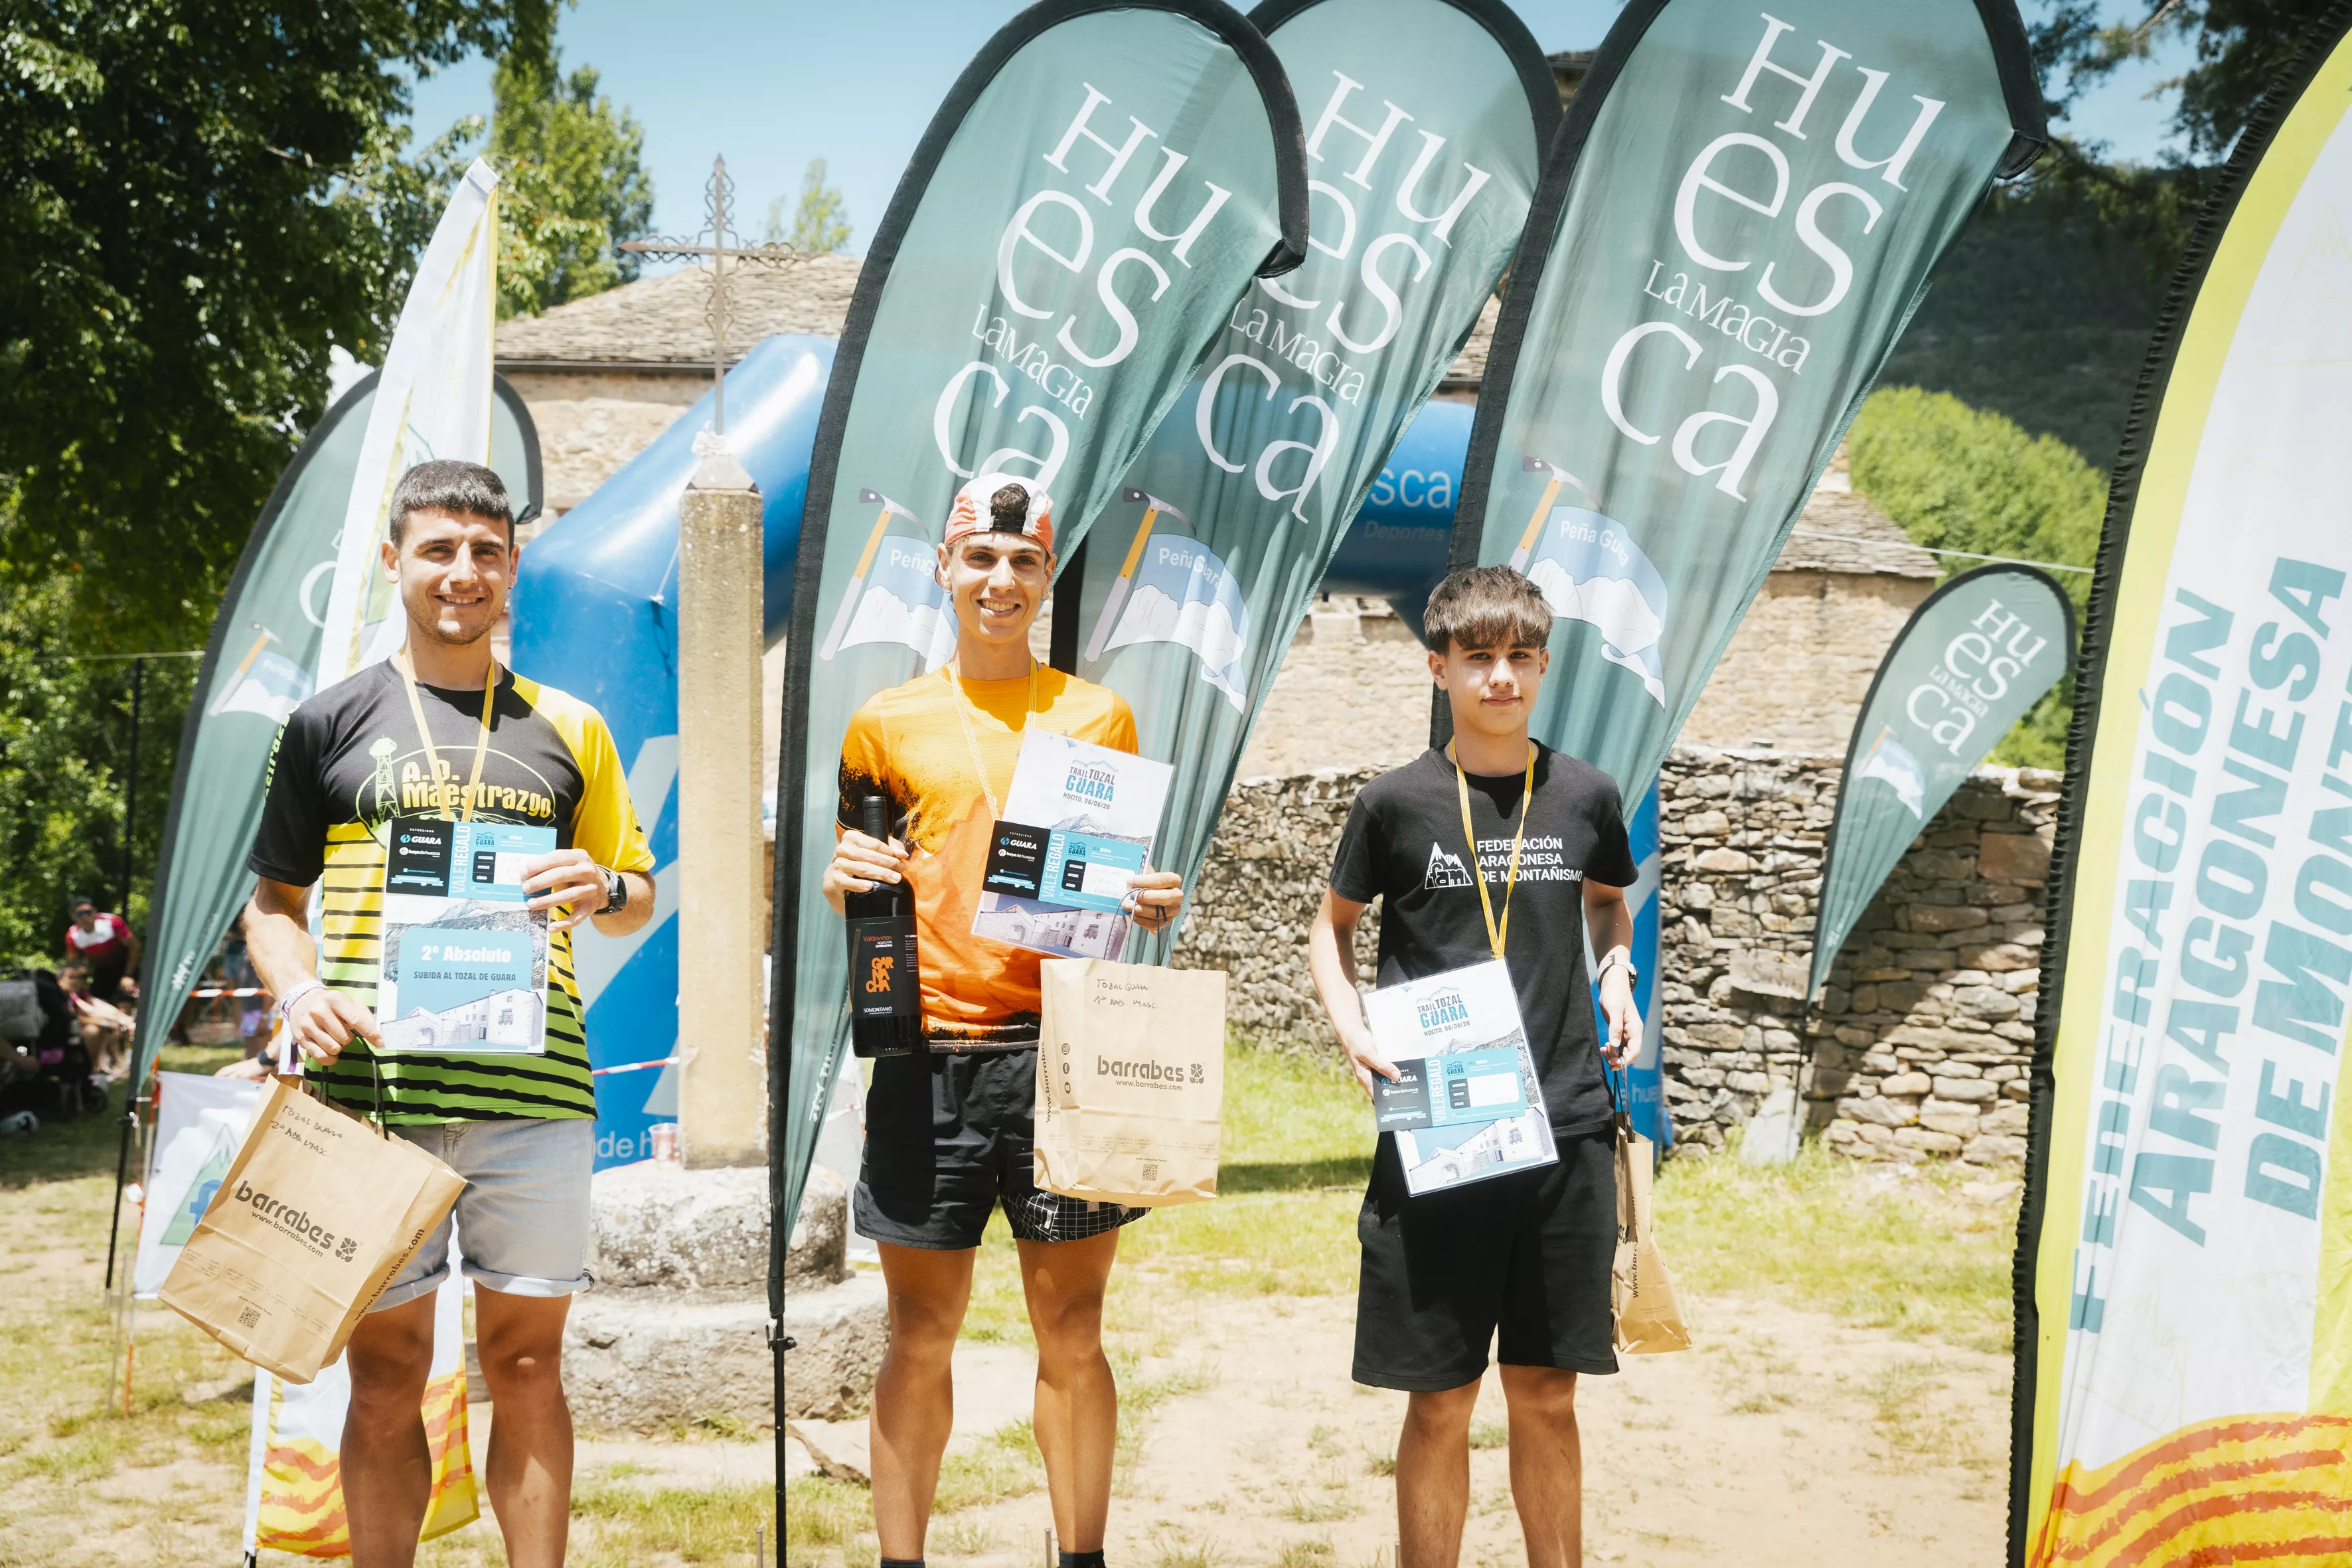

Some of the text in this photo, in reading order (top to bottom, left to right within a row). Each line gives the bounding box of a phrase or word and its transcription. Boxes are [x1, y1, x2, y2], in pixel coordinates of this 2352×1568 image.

[1721, 13, 1946, 193] Hu
[1042, 82, 1232, 268] Hu
[1306, 70, 1492, 248] Hu
[1674, 132, 1884, 317] es
[996, 189, 1171, 368] es
[1196, 353, 1340, 524] ca
[1601, 321, 1779, 503] ca
[1159, 548, 1193, 568] Peña
[1365, 520, 1445, 541] Deportes
[1560, 520, 1597, 543] Peña
[1970, 598, 2049, 668] Hu
[1944, 632, 2022, 701] es
[1907, 683, 1975, 757] ca
[402, 782, 551, 819] Maestrazgo
[1063, 792, 1111, 810] NOCITO, 06/06/26
[1065, 775, 1114, 802] GUARA
[1070, 767, 1115, 785] TRAIL TOZAL
[411, 836, 441, 844] GUARA
[451, 825, 471, 894] VALE REGALO
[1010, 839, 1037, 850] GUARA
[1041, 833, 1065, 898] VALE REGALO
[1068, 848, 1086, 856] GUARA
[2128, 556, 2347, 1248] ARAGONESA
[443, 945, 512, 963] Absoluto
[2069, 587, 2235, 1333] FEDERACIÓN
[1417, 994, 1462, 1013] TRAIL TOZAL
[1420, 1004, 1468, 1028] GUARA
[1445, 1020, 1470, 1031] 06/06/26
[1097, 1055, 1184, 1083] barrabes
[1115, 1079, 1182, 1091] www.barrabes.com
[1427, 1059, 1447, 1123] VALE REGALO
[597, 1131, 634, 1158] de
[2244, 1058, 2331, 1221] DE
[234, 1180, 335, 1249] barrabes
[252, 1211, 323, 1257] www.barrabes.com
[353, 1228, 425, 1322] www.barrabes.com
